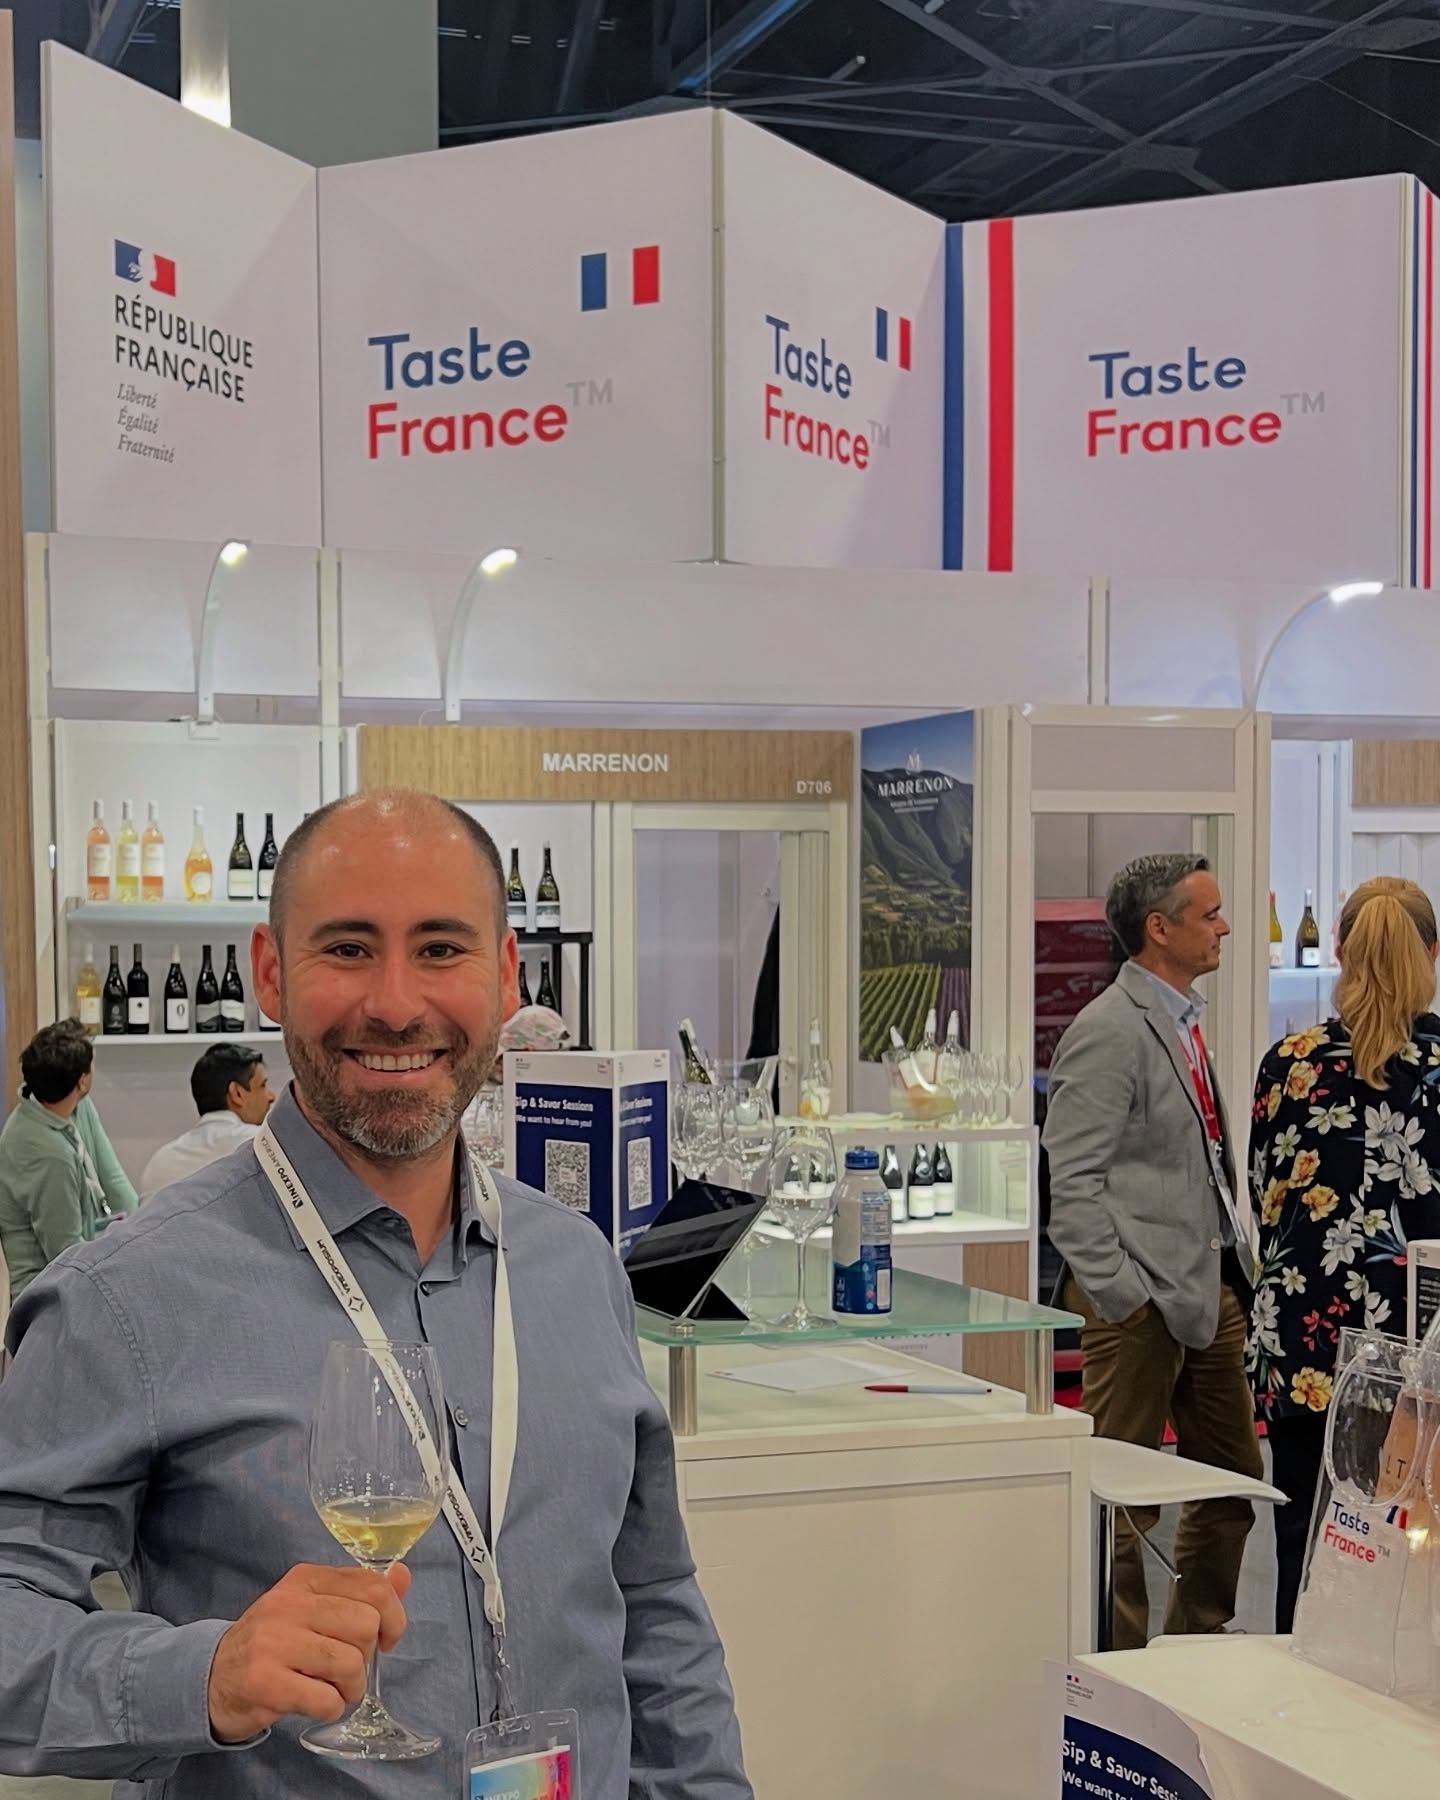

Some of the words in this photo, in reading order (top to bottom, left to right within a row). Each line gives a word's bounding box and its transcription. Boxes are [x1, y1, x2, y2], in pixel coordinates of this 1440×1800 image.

[115, 294, 253, 369] RÉPUBLIQUE
[115, 335, 245, 403] FRANÇAISE
[368, 327, 530, 390] Taste
[765, 314, 852, 399] Taste
[1088, 346, 1247, 399] Taste
[117, 383, 158, 408] Liberté
[117, 406, 159, 434] Égalité
[368, 402, 568, 459] France
[765, 383, 869, 470] France
[1088, 409, 1282, 457] France
[117, 434, 175, 464] Fraternité
[542, 752, 669, 772] MARRENON
[796, 779, 832, 794] D706
[878, 775, 953, 797] MARRENON
[1332, 1500, 1370, 1535] Taste
[1323, 1523, 1376, 1563] France
[1061, 1739, 1086, 1765] Sip
[1090, 1750, 1102, 1769] &
[1106, 1756, 1147, 1788] Savor
[1062, 1769, 1083, 1788] We
[1084, 1781, 1114, 1800] want
